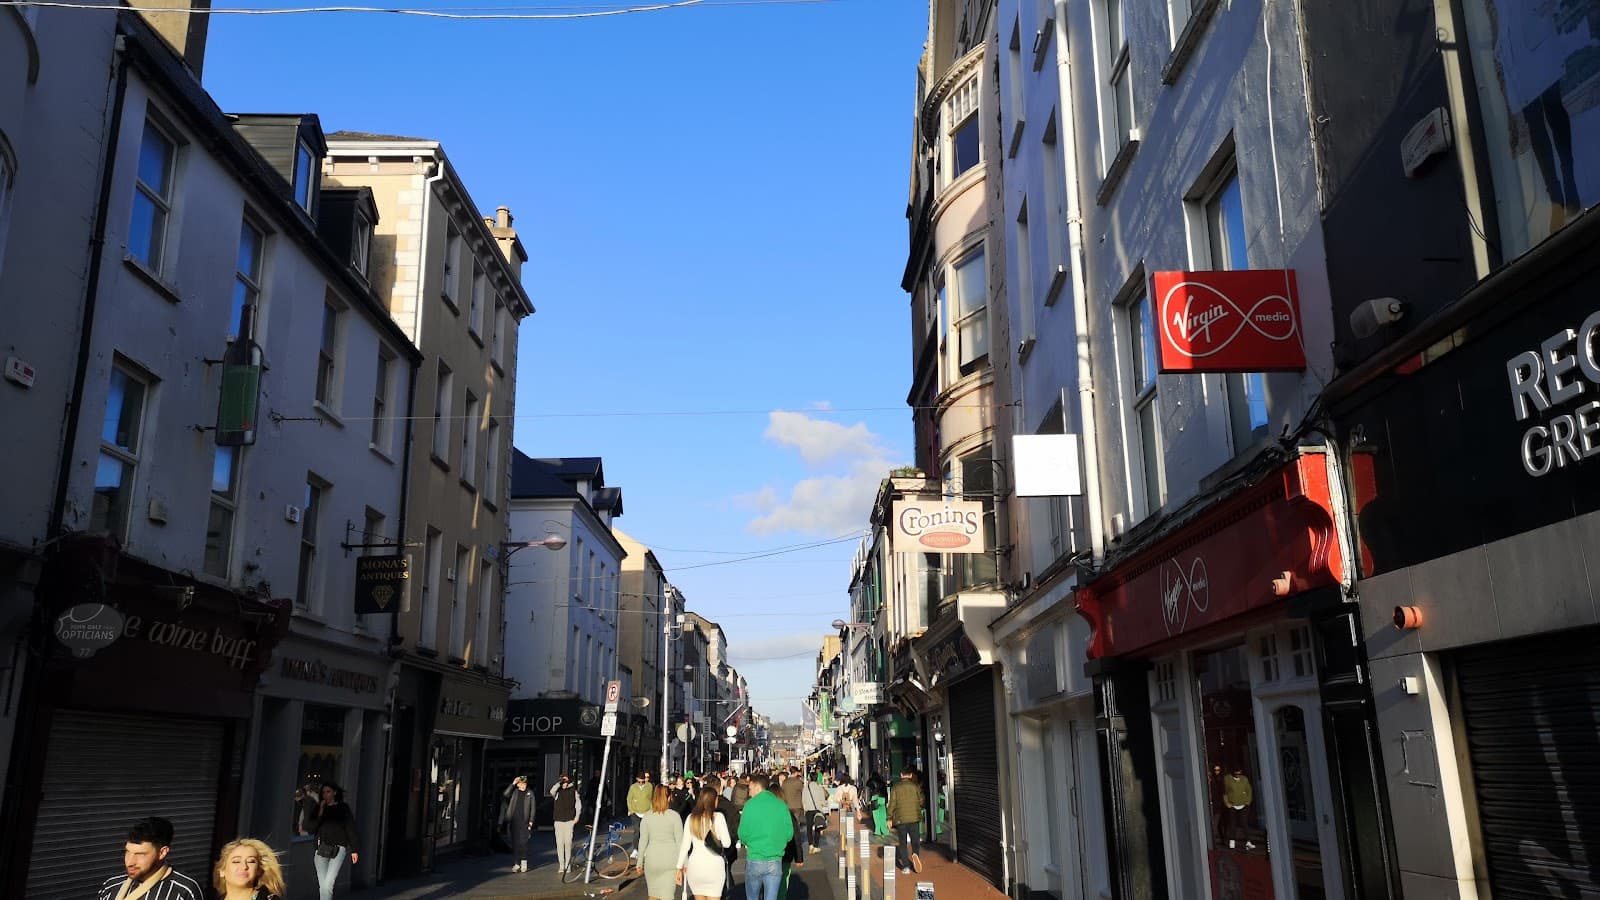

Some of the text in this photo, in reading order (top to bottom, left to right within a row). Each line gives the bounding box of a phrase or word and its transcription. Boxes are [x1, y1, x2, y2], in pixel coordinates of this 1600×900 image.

[1173, 295, 1290, 343] Virgin media
[899, 506, 978, 536] Cronins
[361, 559, 408, 569] MONA'S
[360, 570, 409, 581] ANTIQUES
[62, 630, 114, 640] OPTICIANS
[148, 620, 209, 651] wine
[210, 627, 257, 669] buff
[511, 716, 564, 733] SHOP
